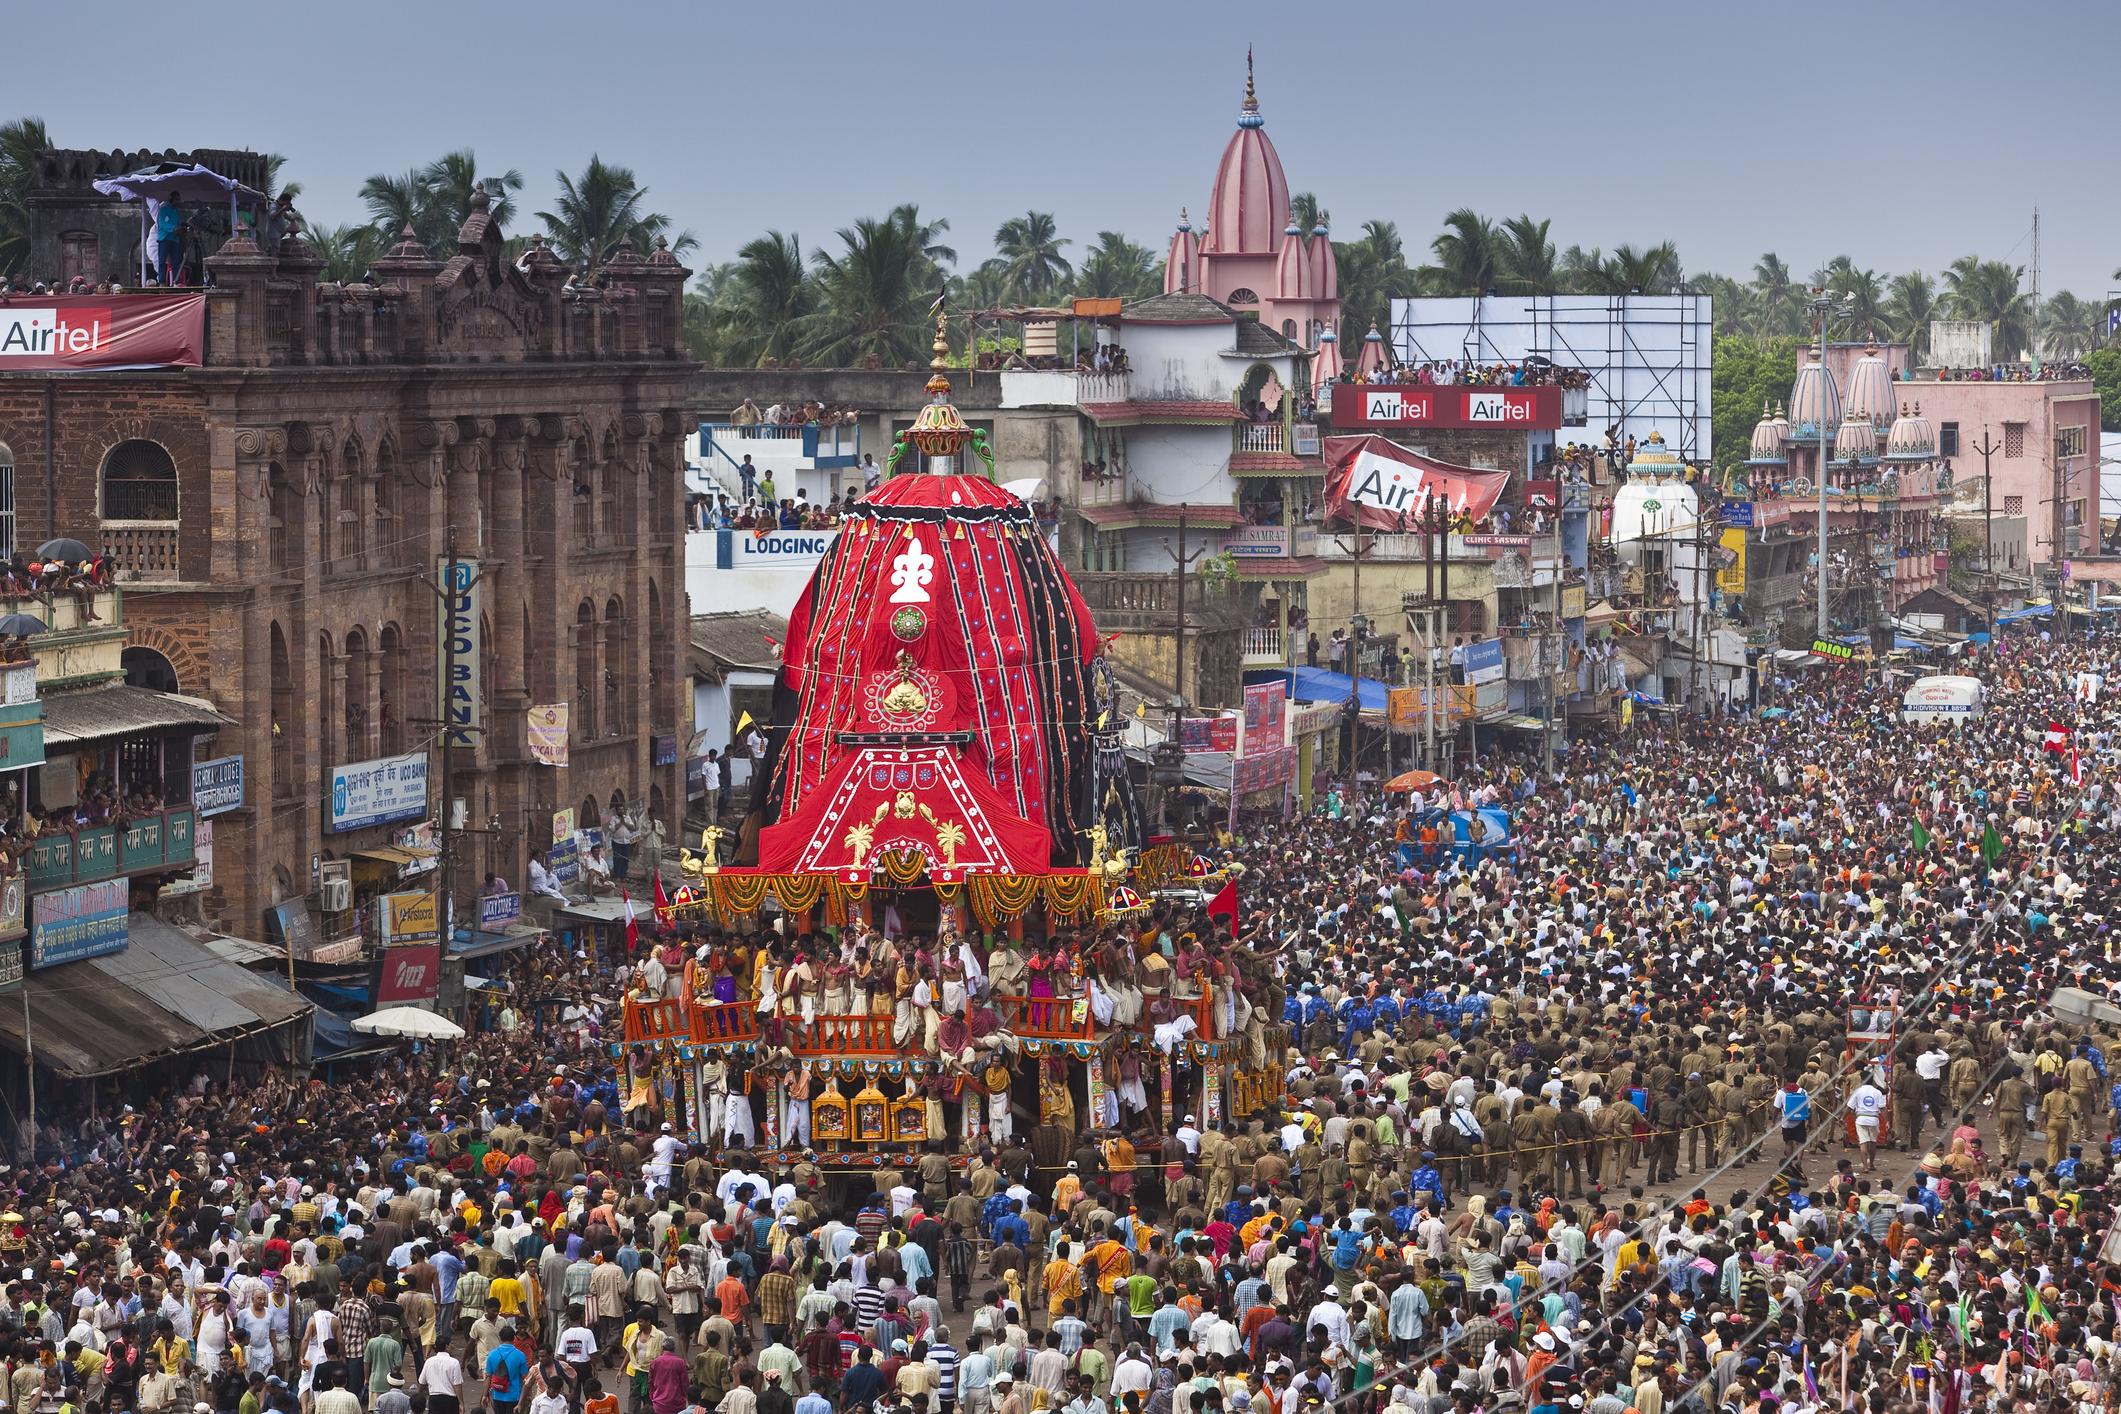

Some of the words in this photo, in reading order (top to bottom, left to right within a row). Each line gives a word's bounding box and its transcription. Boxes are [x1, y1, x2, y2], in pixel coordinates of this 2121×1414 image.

[2, 319, 99, 352] Airtel
[1370, 398, 1427, 419] Airtel
[1472, 400, 1530, 420] Airtel
[1220, 530, 1249, 542] HOTEL
[1250, 530, 1286, 542] SAMRAT
[1465, 536, 1492, 544] CLINIC
[1494, 536, 1529, 544] SASWAT
[744, 538, 825, 554] LODGING
[443, 596, 472, 655] UCO
[1919, 688, 1941, 696] DRINKING
[1942, 688, 1955, 696] WATER
[195, 767, 214, 787] ASHOKA
[219, 762, 239, 782] LODGE
[400, 764, 411, 782] UCO
[412, 762, 427, 779] BANK
[336, 821, 347, 830] FULLY
[80, 838, 94, 861] राम
[99, 834, 114, 856] राम
[126, 828, 141, 850] राम
[144, 825, 159, 847] राम
[173, 820, 187, 842] राम
[324, 865, 342, 873] WESTERN
[65, 892, 77, 920] LAL
[79, 885, 110, 917] MARWARI
[112, 881, 128, 910] BASA
[497, 896, 511, 914] STORE
[407, 905, 434, 922] Aristocrat
